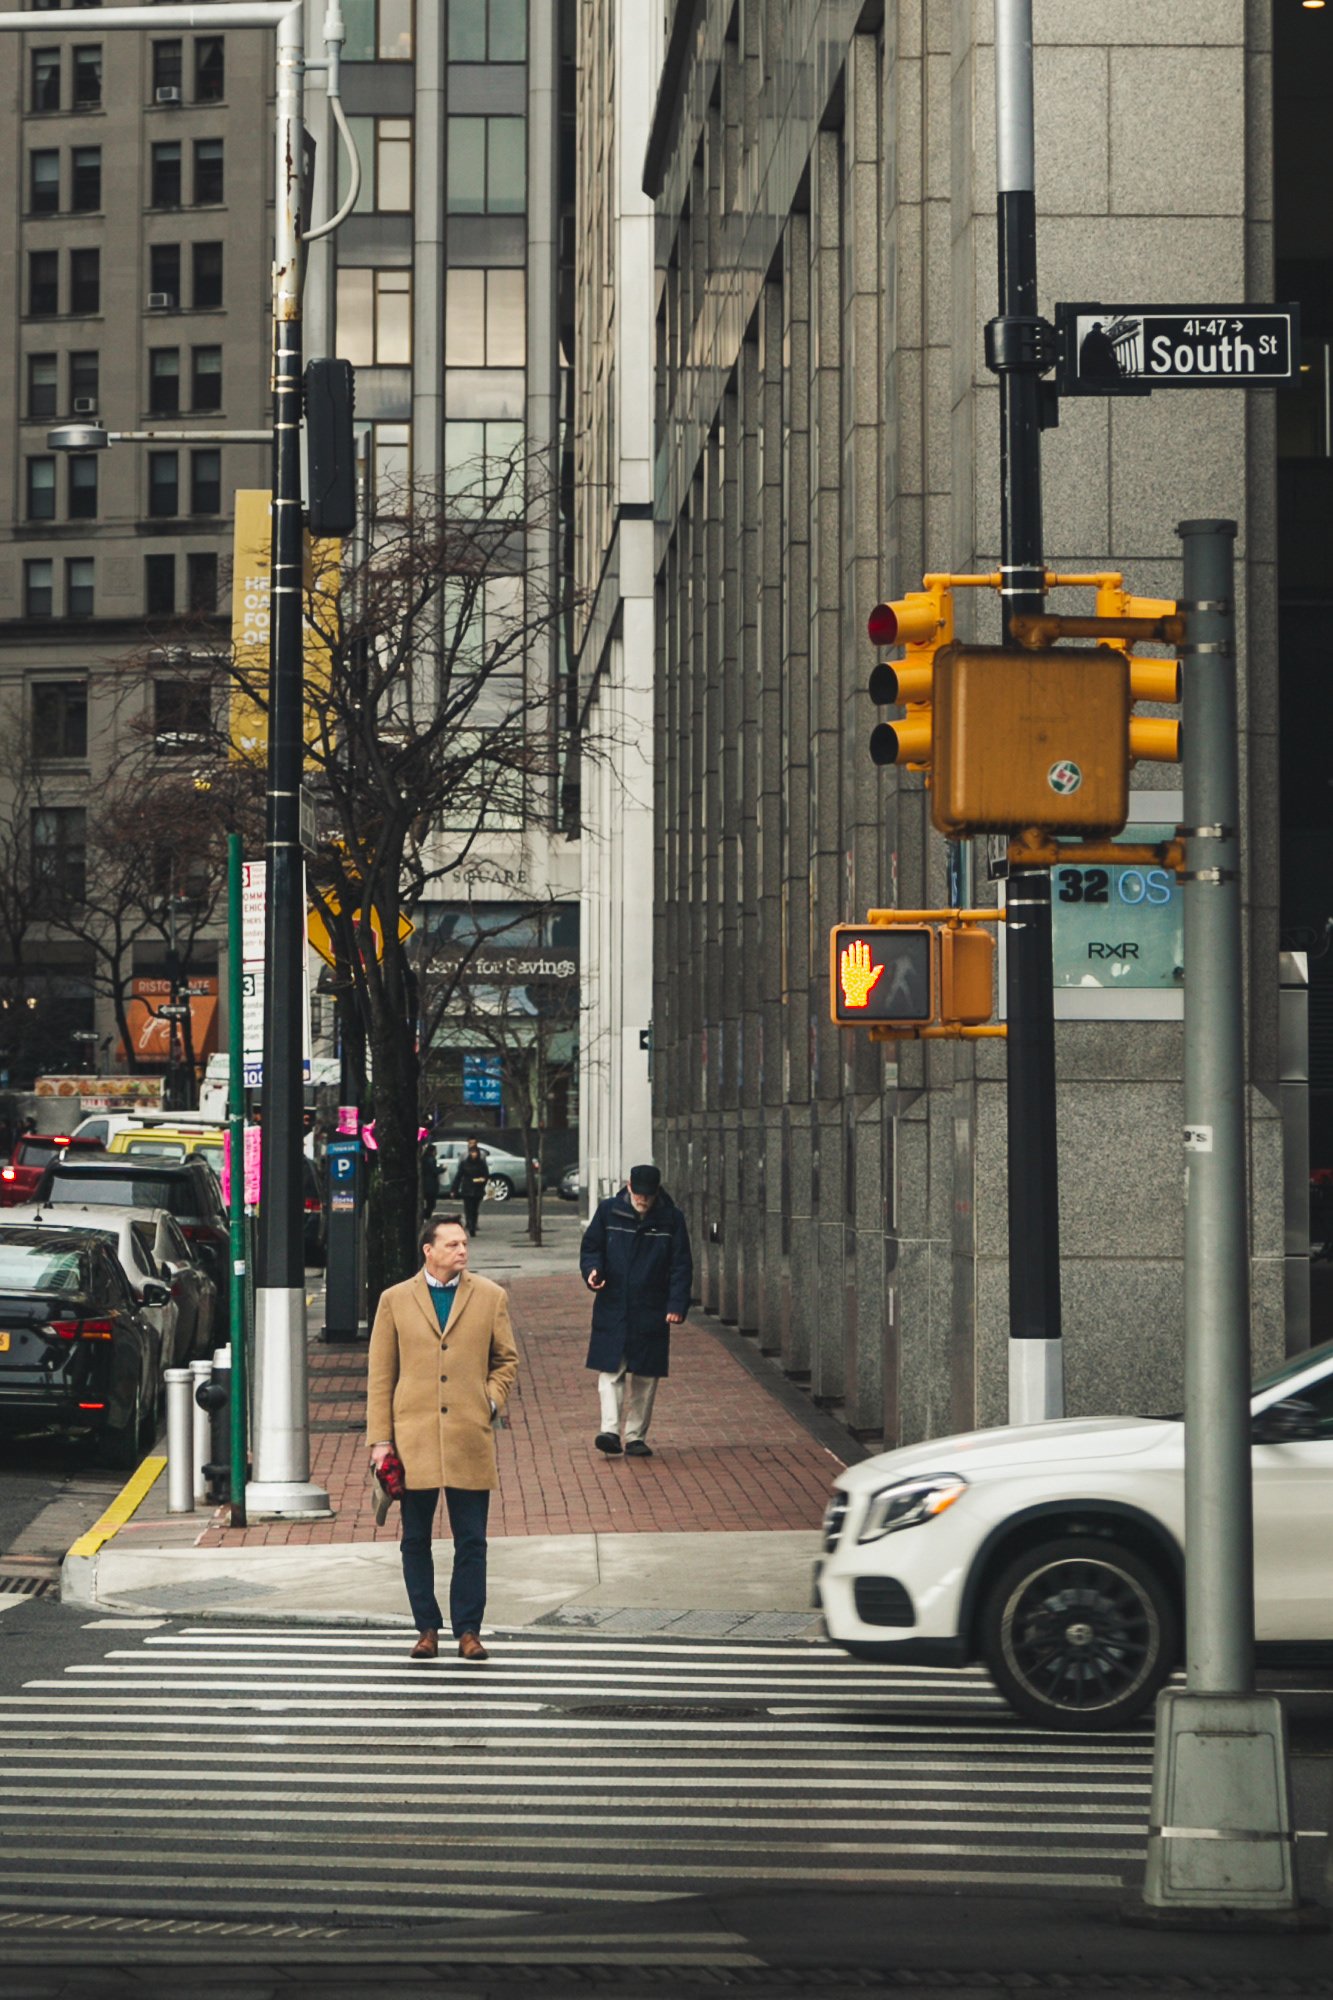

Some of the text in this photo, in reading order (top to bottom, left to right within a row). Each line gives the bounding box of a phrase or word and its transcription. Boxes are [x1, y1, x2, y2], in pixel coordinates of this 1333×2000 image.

[1183, 319, 1227, 336] 41-47
[1150, 335, 1278, 373] South St
[1058, 869, 1171, 905] 32 OS
[1088, 942, 1140, 959] RXR
[476, 957, 504, 974] for
[506, 957, 576, 978] Savings
[242, 976, 254, 996] 3
